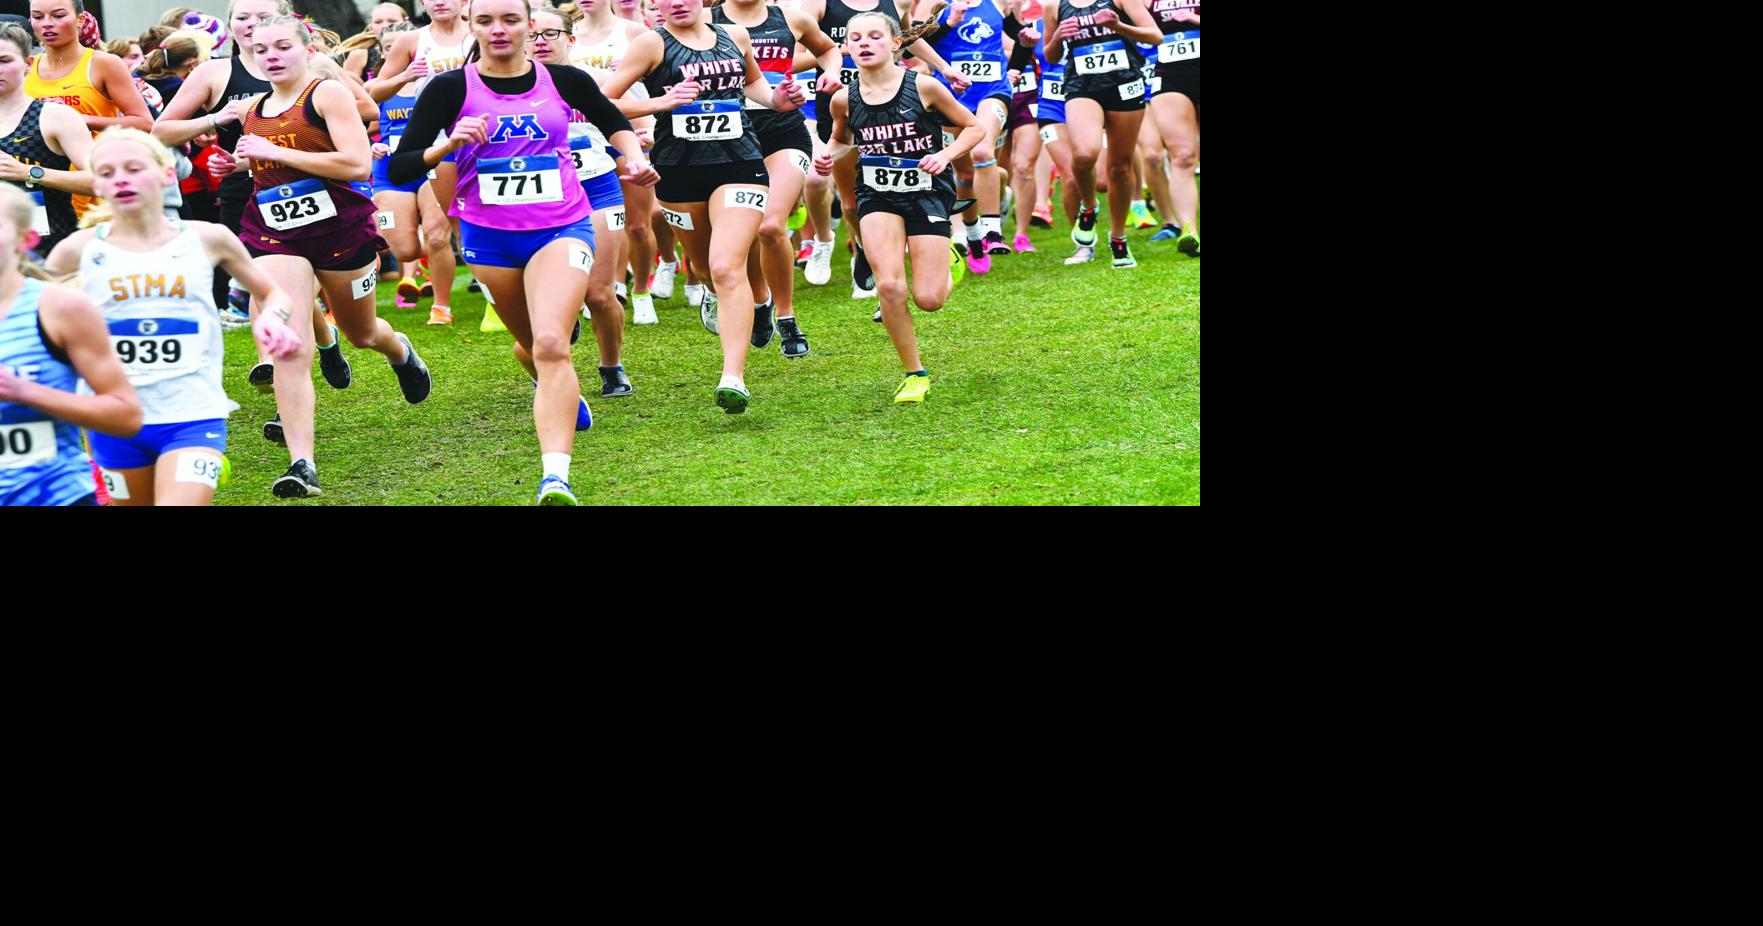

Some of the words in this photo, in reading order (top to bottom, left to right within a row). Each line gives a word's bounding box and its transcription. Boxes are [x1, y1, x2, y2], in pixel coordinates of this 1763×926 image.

[1168, 41, 1196, 56] 761
[679, 58, 742, 79] WHITE
[961, 63, 991, 76] 822
[1085, 53, 1118, 69] 874
[685, 114, 731, 134] 872
[859, 121, 917, 141] WHITE
[891, 134, 933, 154] LAKE
[492, 173, 543, 197] 771
[874, 168, 919, 187] 878
[270, 196, 320, 222] 923
[735, 191, 765, 208] 872
[109, 273, 186, 301] STMA
[116, 338, 181, 364] 939
